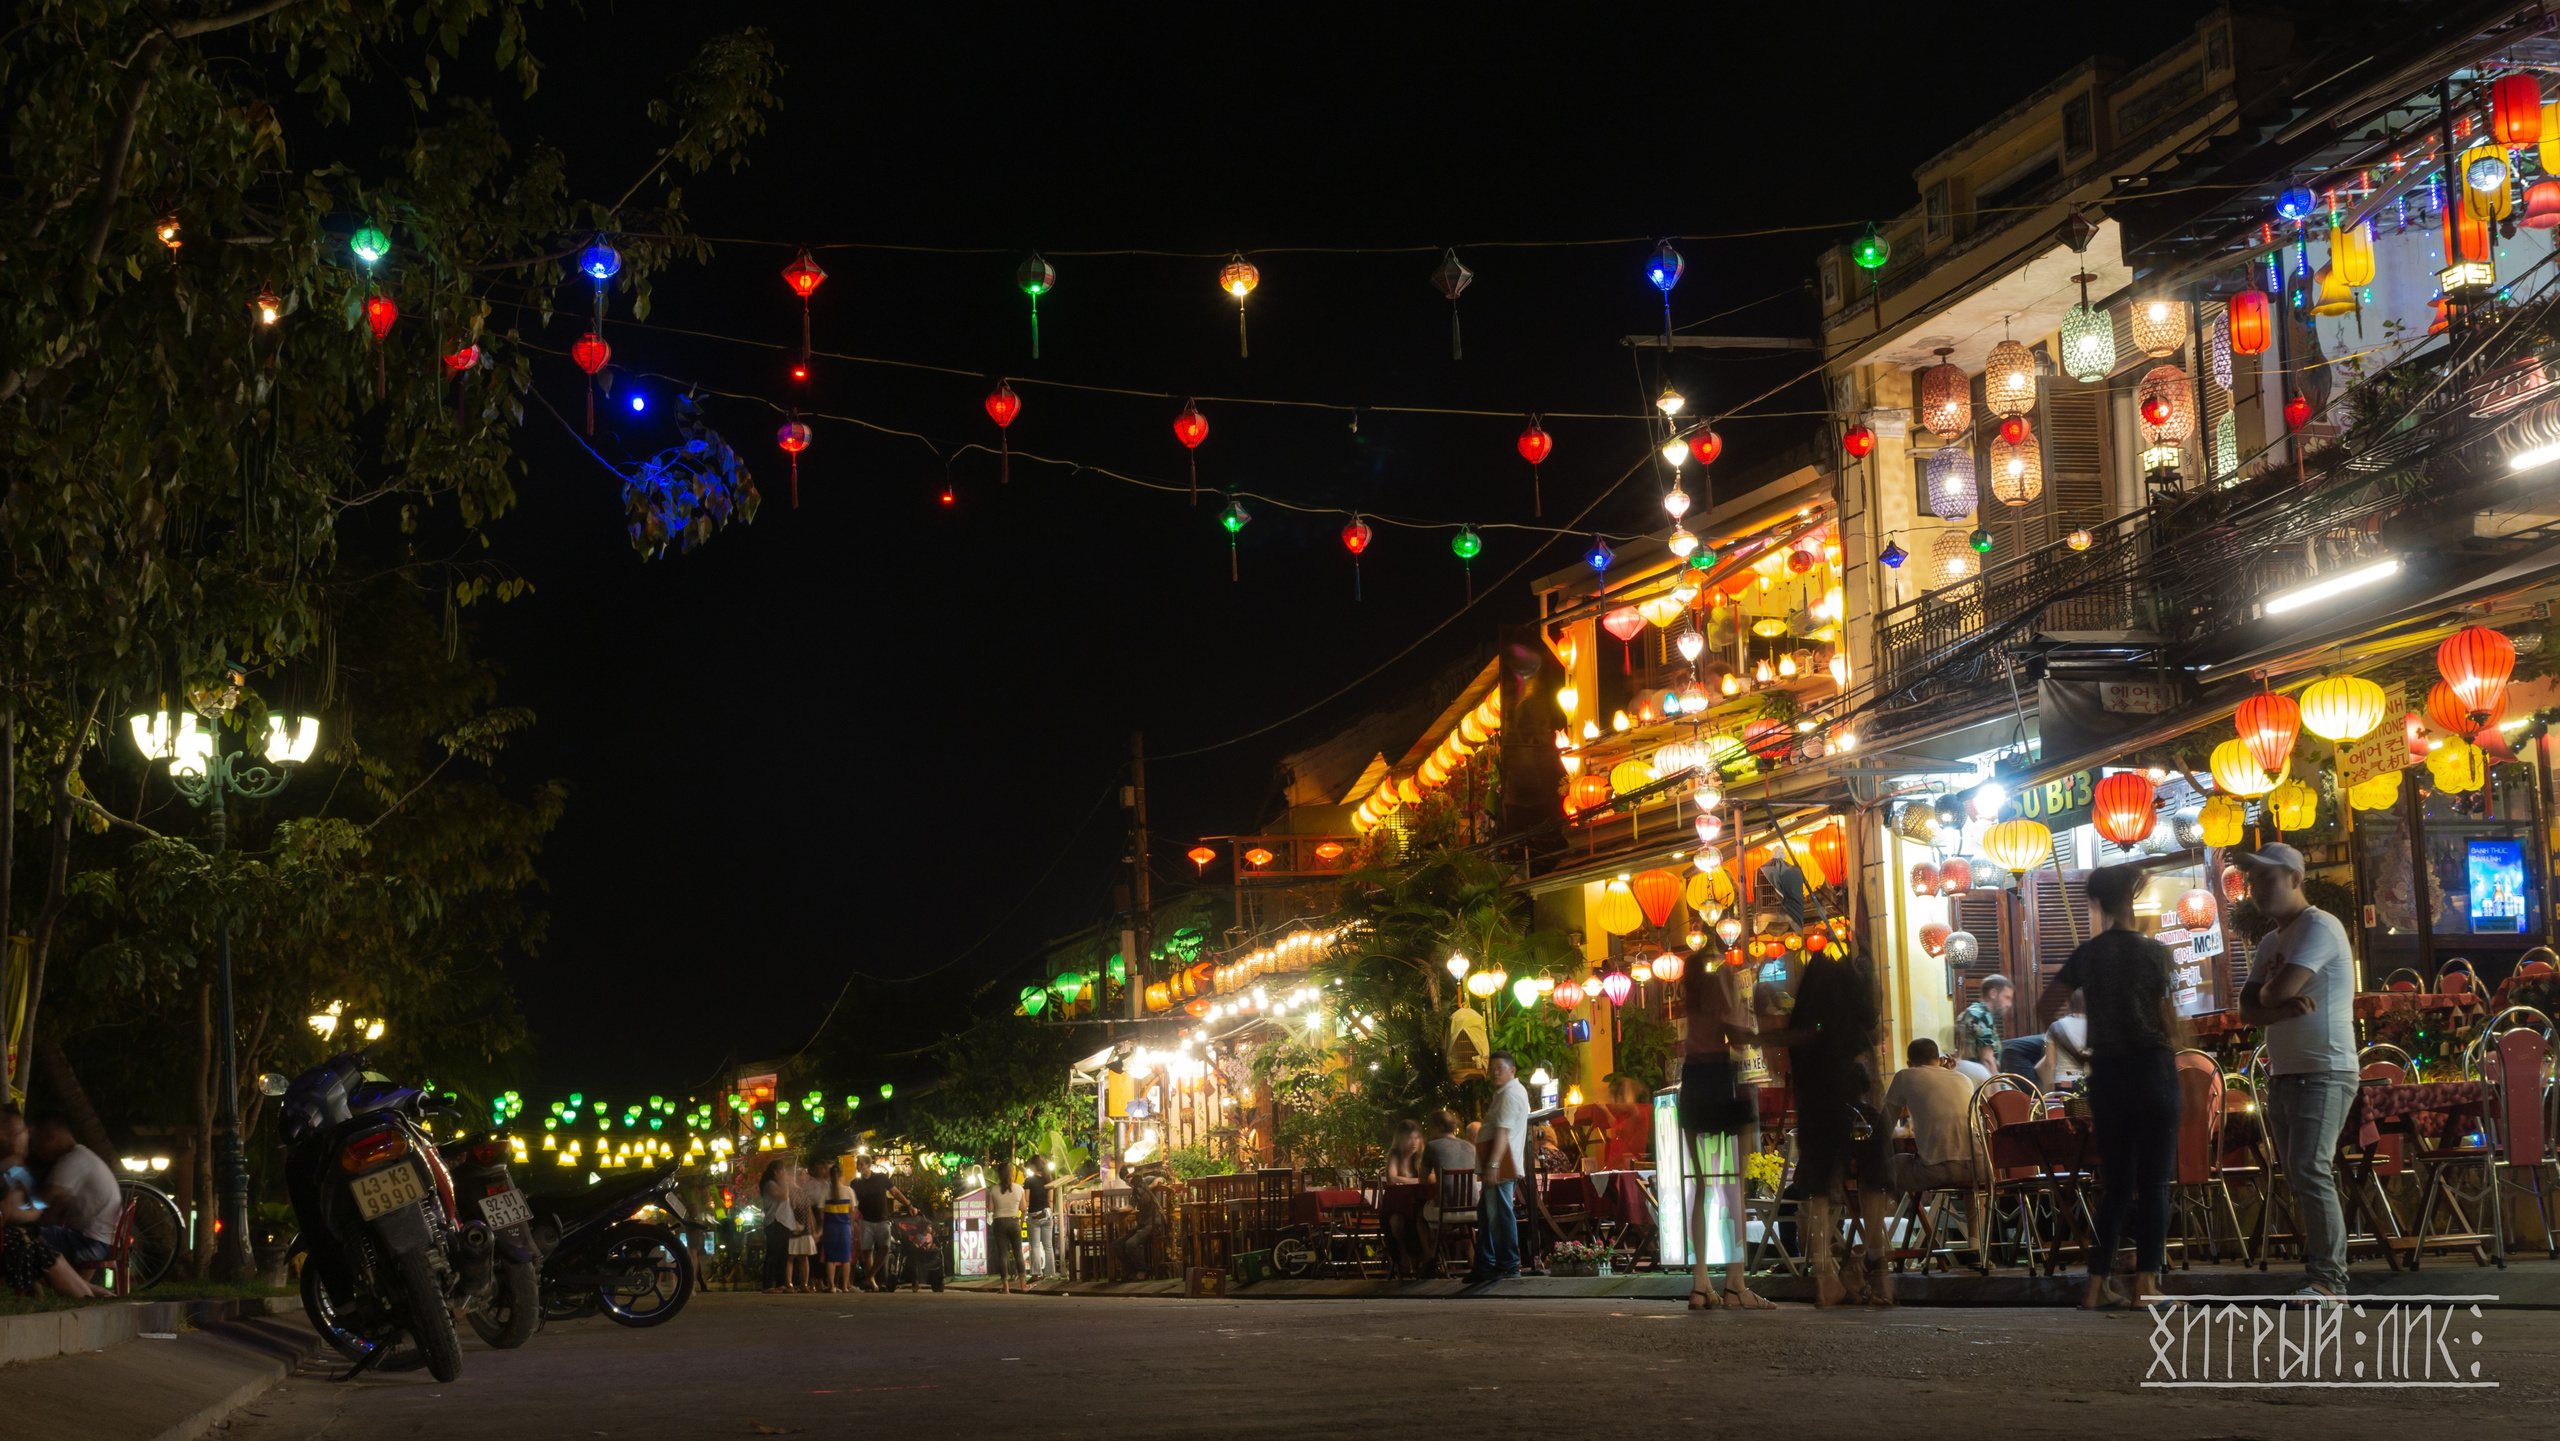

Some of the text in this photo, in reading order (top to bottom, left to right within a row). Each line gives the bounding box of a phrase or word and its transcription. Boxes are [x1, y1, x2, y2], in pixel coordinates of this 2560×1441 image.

[2155, 929, 2192, 944] CONDITIONE
[360, 1166, 411, 1197] 43-K3
[368, 1184, 417, 1215] 9990
[486, 1193, 518, 1212] 92-D1
[489, 1206, 530, 1228] 351.32
[960, 1230, 986, 1260] SPA
